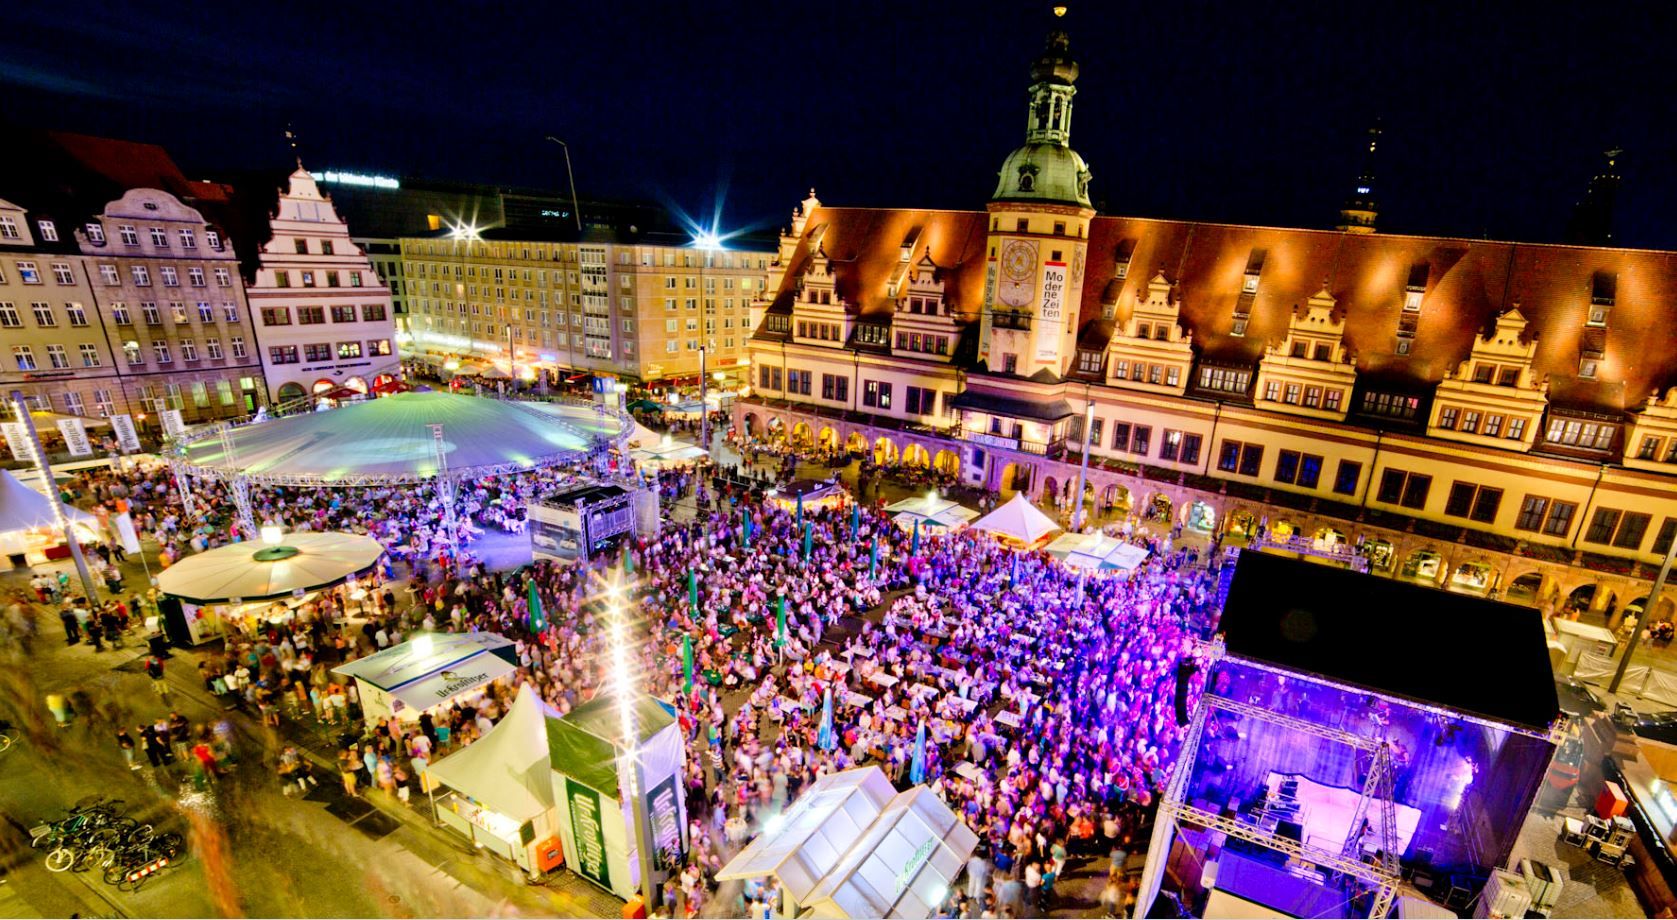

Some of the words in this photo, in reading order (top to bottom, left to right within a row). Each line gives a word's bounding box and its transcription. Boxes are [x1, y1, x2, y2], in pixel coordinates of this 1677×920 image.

[1046, 271, 1063, 282] Mo
[1045, 281, 1062, 291] der
[1044, 291, 1057, 299] ne
[1043, 299, 1059, 309] Zei
[1043, 309, 1059, 317] ten
